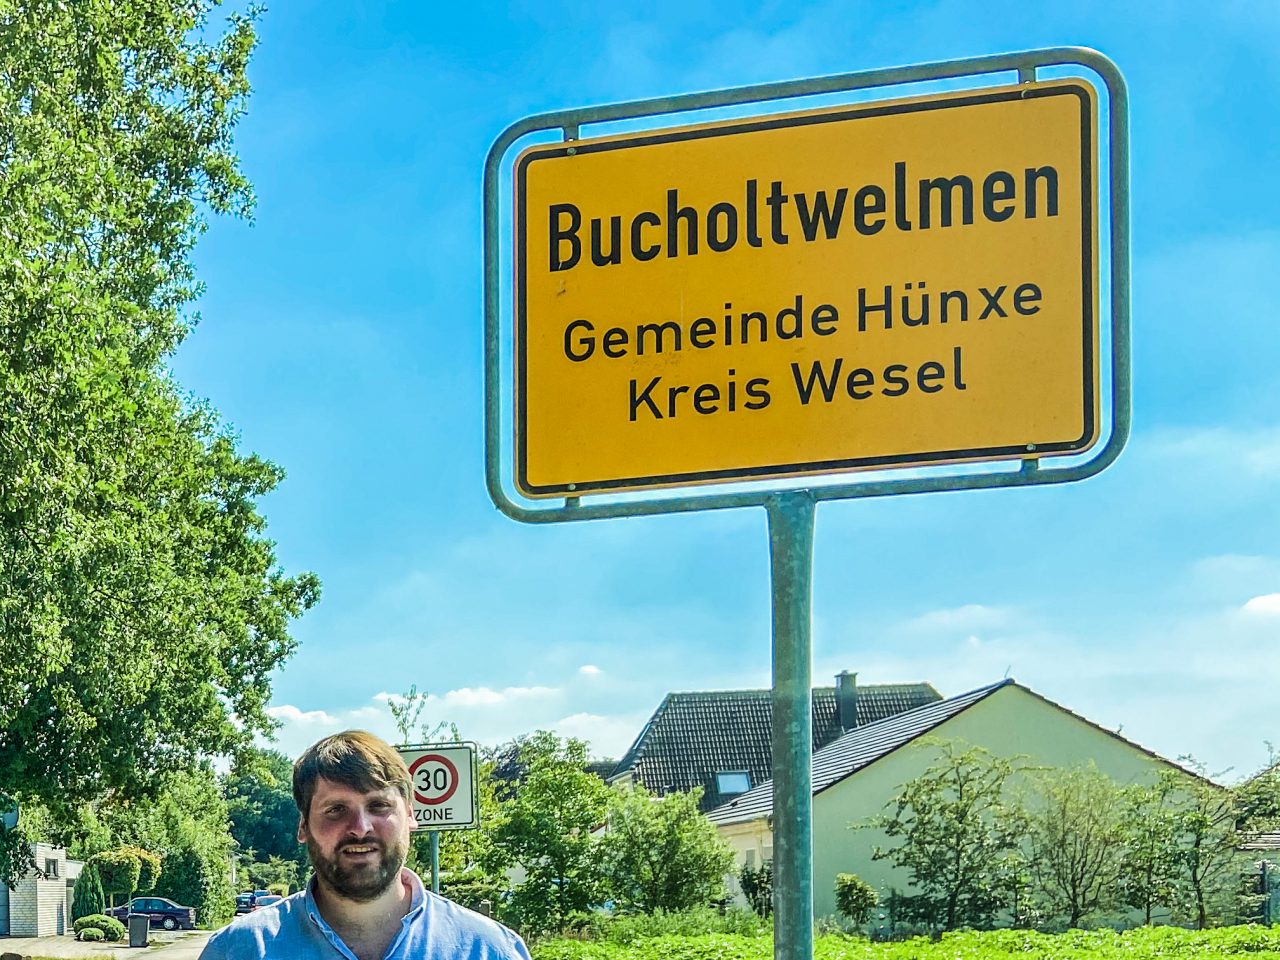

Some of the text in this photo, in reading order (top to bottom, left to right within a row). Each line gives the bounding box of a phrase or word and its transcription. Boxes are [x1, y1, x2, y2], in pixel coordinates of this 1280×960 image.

[549, 161, 1060, 272] Bucholtwelmen
[563, 281, 1043, 363] Gemeinde Hünxe
[629, 346, 967, 422] Kreis Wesel
[414, 807, 453, 821] ZONE
[417, 768, 447, 791] 30
